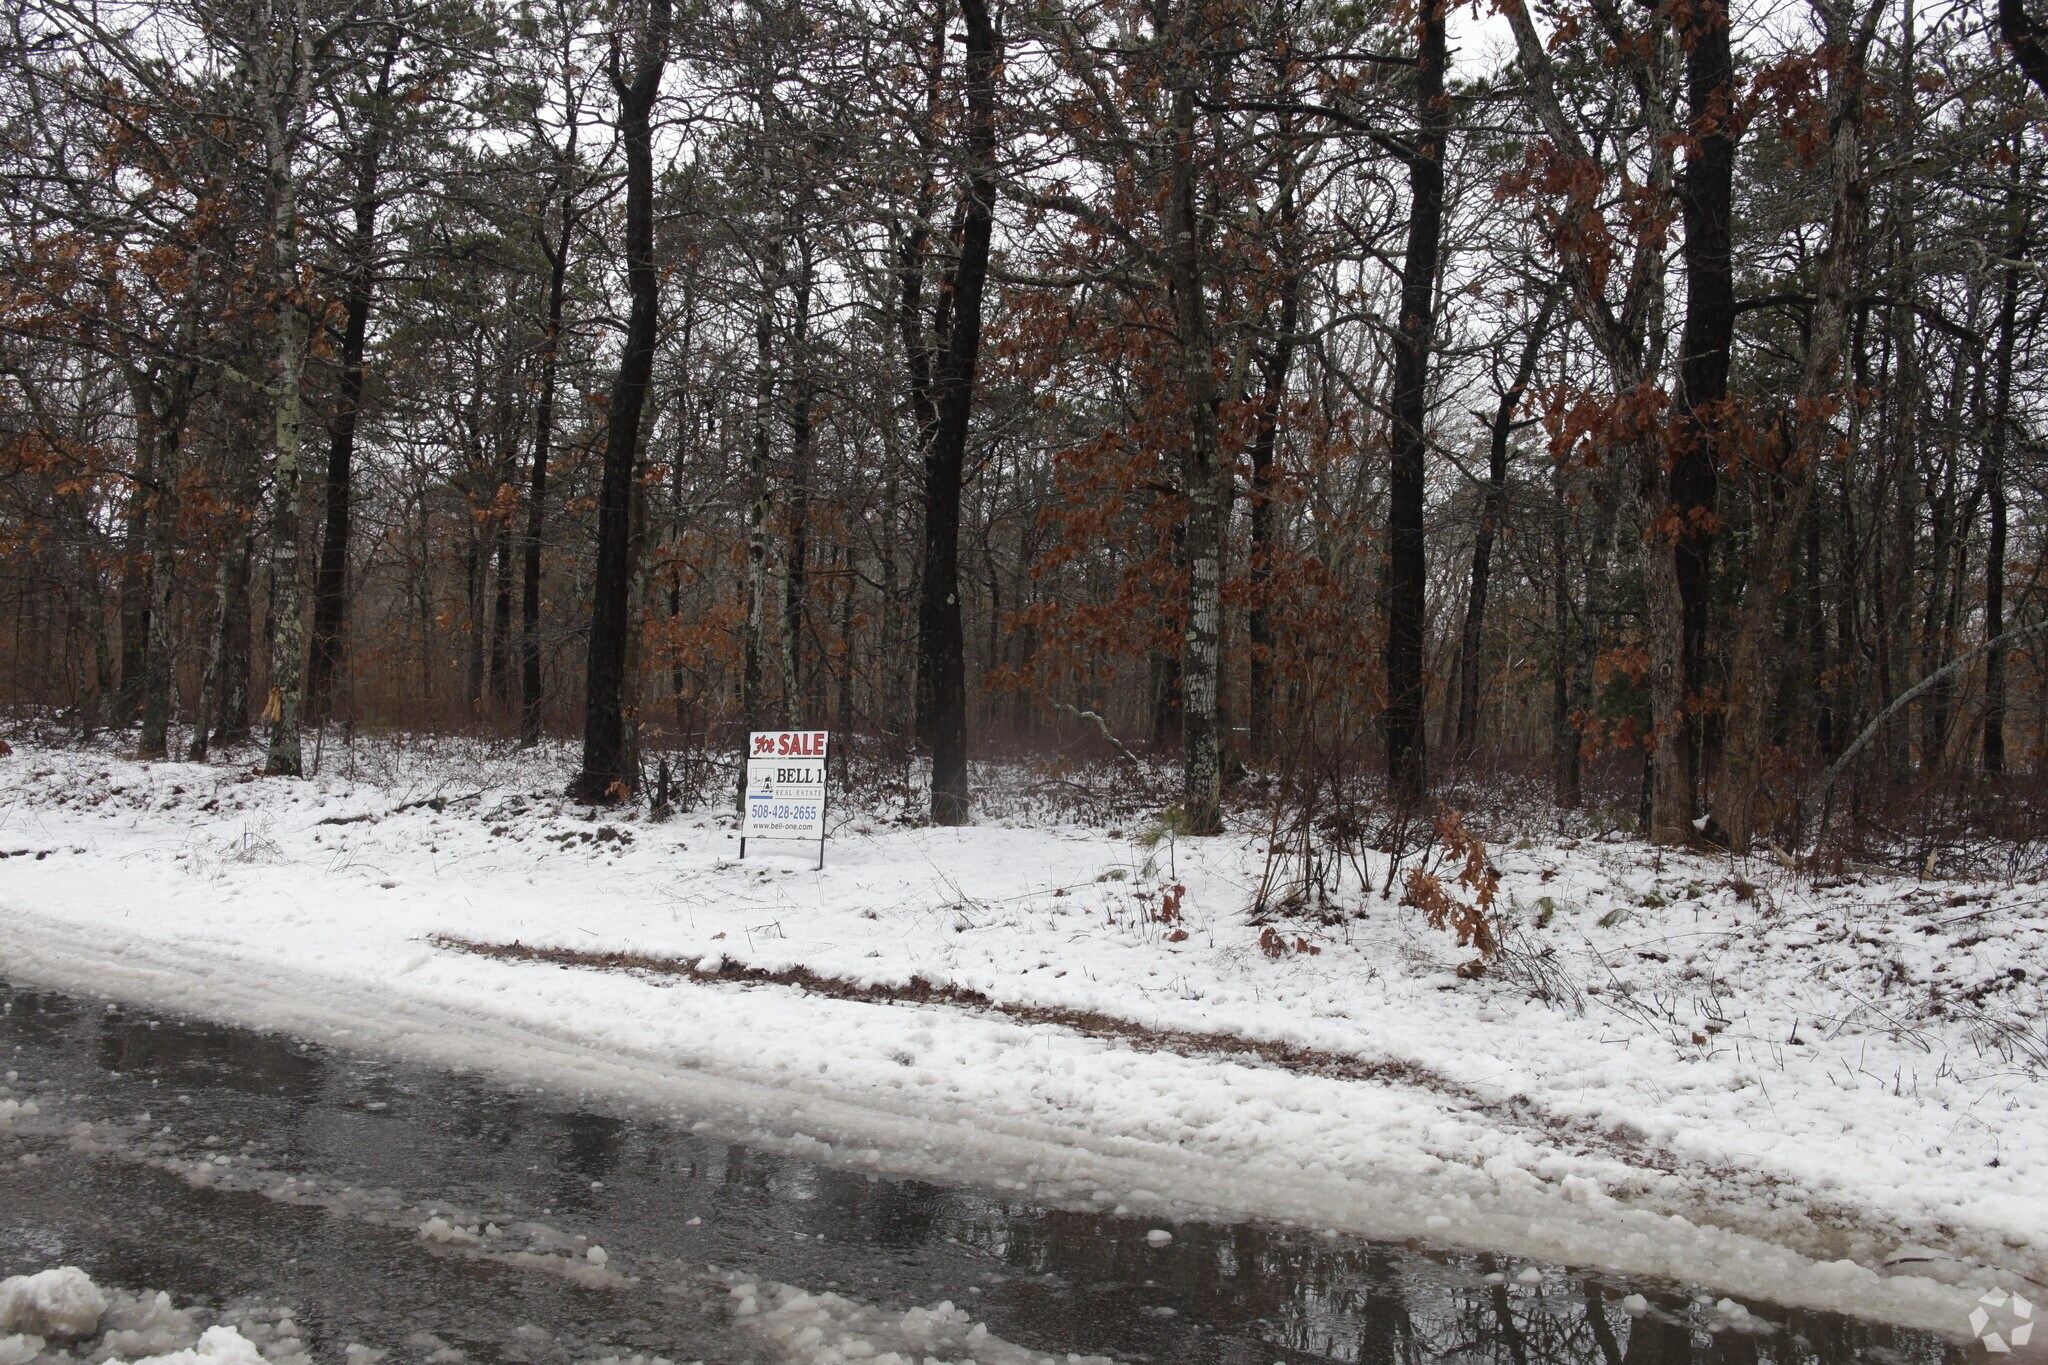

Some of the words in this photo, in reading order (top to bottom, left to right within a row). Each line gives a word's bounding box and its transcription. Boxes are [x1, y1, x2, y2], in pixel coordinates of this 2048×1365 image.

[753, 735, 775, 755] For
[778, 734, 825, 755] SALE
[777, 768, 814, 783] BELL
[817, 769, 822, 783] 1
[752, 805, 816, 820] 508-428-2655
[753, 823, 813, 831] www.bell-one.com
